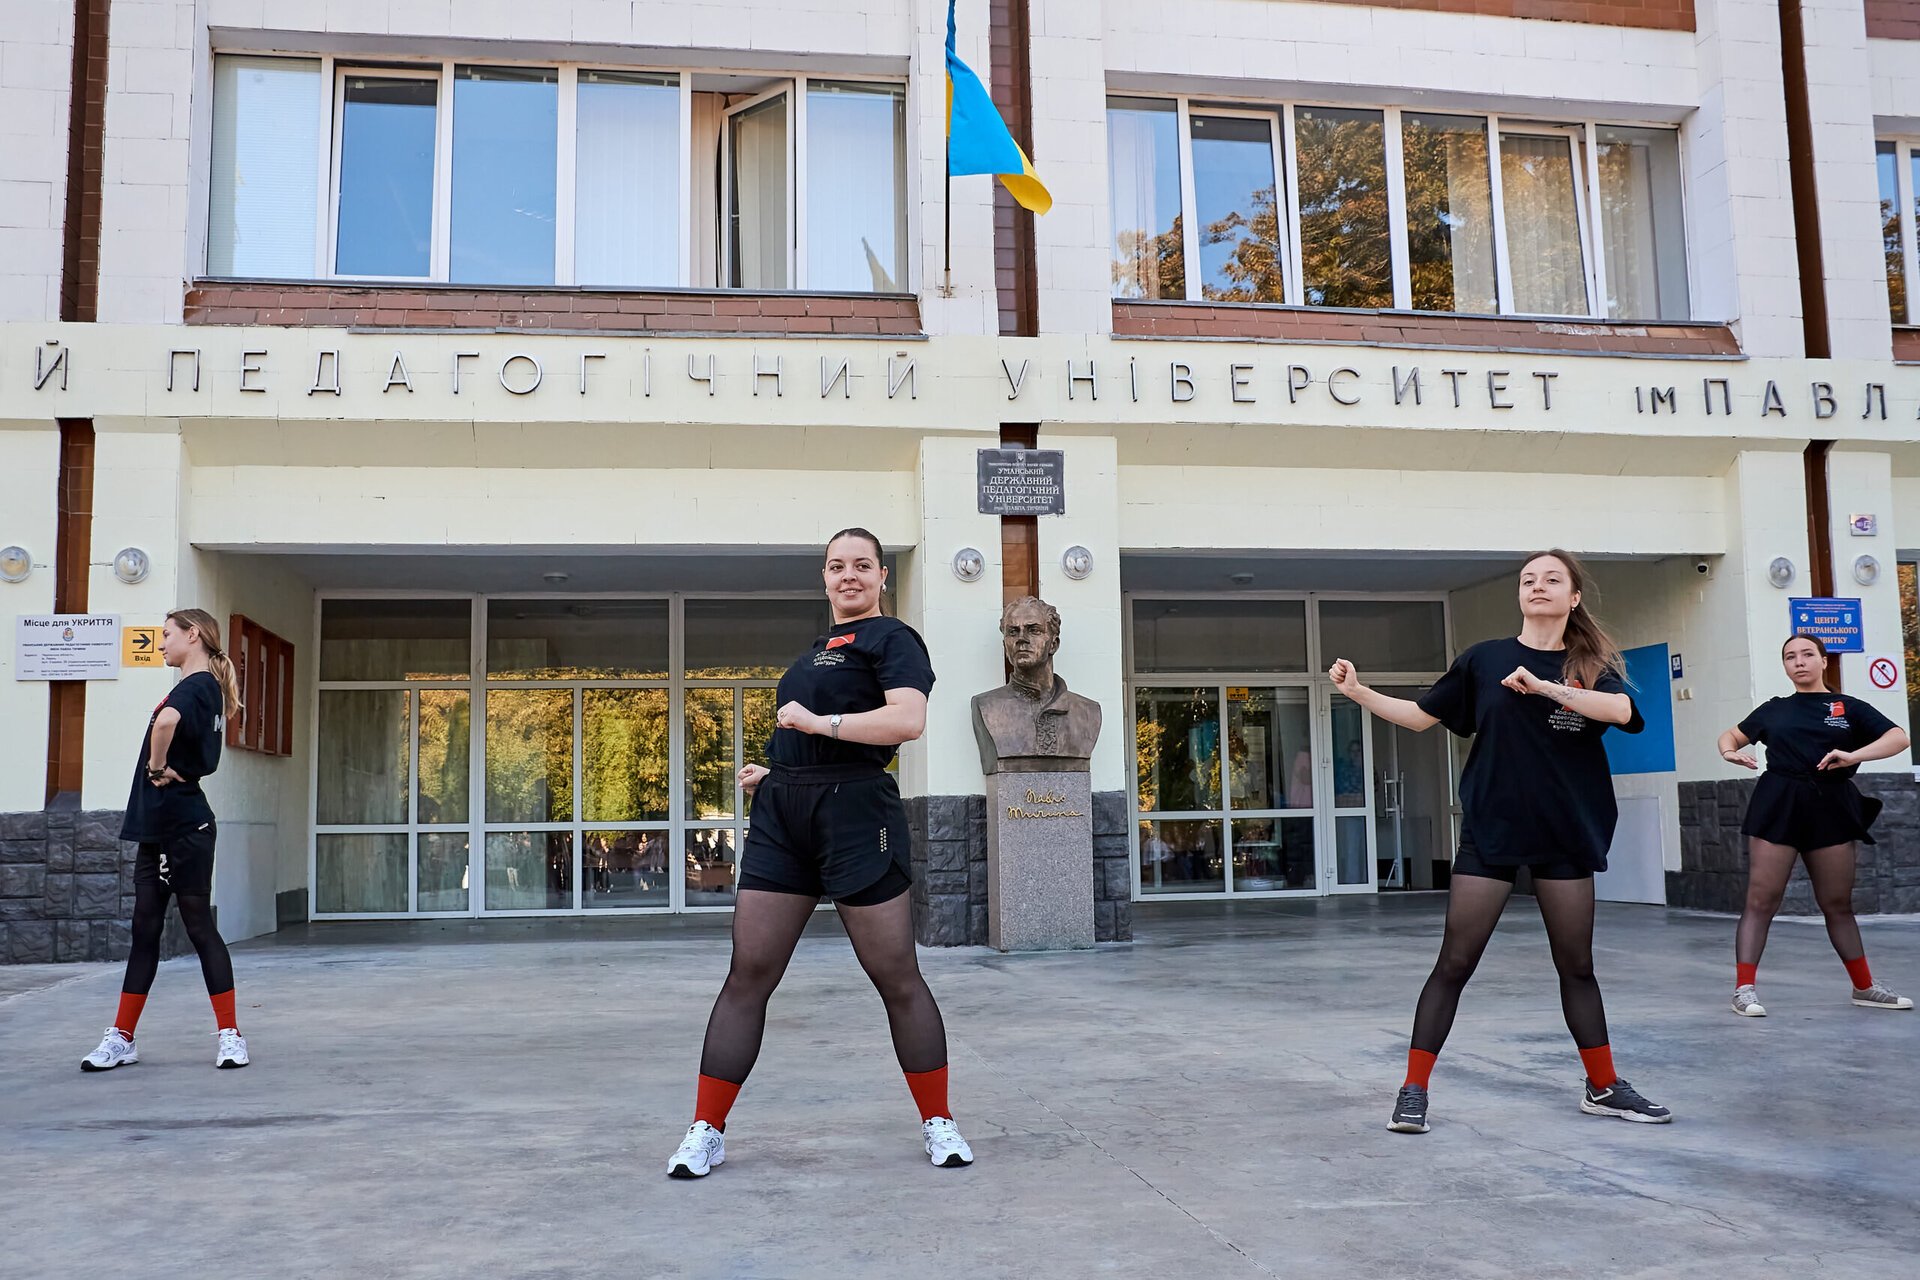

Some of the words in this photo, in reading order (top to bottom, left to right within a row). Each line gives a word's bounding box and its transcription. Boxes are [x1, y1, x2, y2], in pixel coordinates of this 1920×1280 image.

[167, 347, 917, 400] ПЕДАГОГІЧНИЙ
[1000, 355, 1559, 410] УНІВЕРСИТЕТ
[1703, 377, 1920, 420] ПАВЛ
[998, 467, 1044, 475] УМАНСЬКИЙ
[989, 476, 1052, 485] ДЕРЖАВНИЙ
[983, 485, 1059, 495] ПЕДАГОГІЧНИЙ
[988, 495, 1054, 504] УНІВЕРСИТЕТ
[24, 619, 50, 628] Місце
[72, 618, 113, 627] УКРИТТЯ
